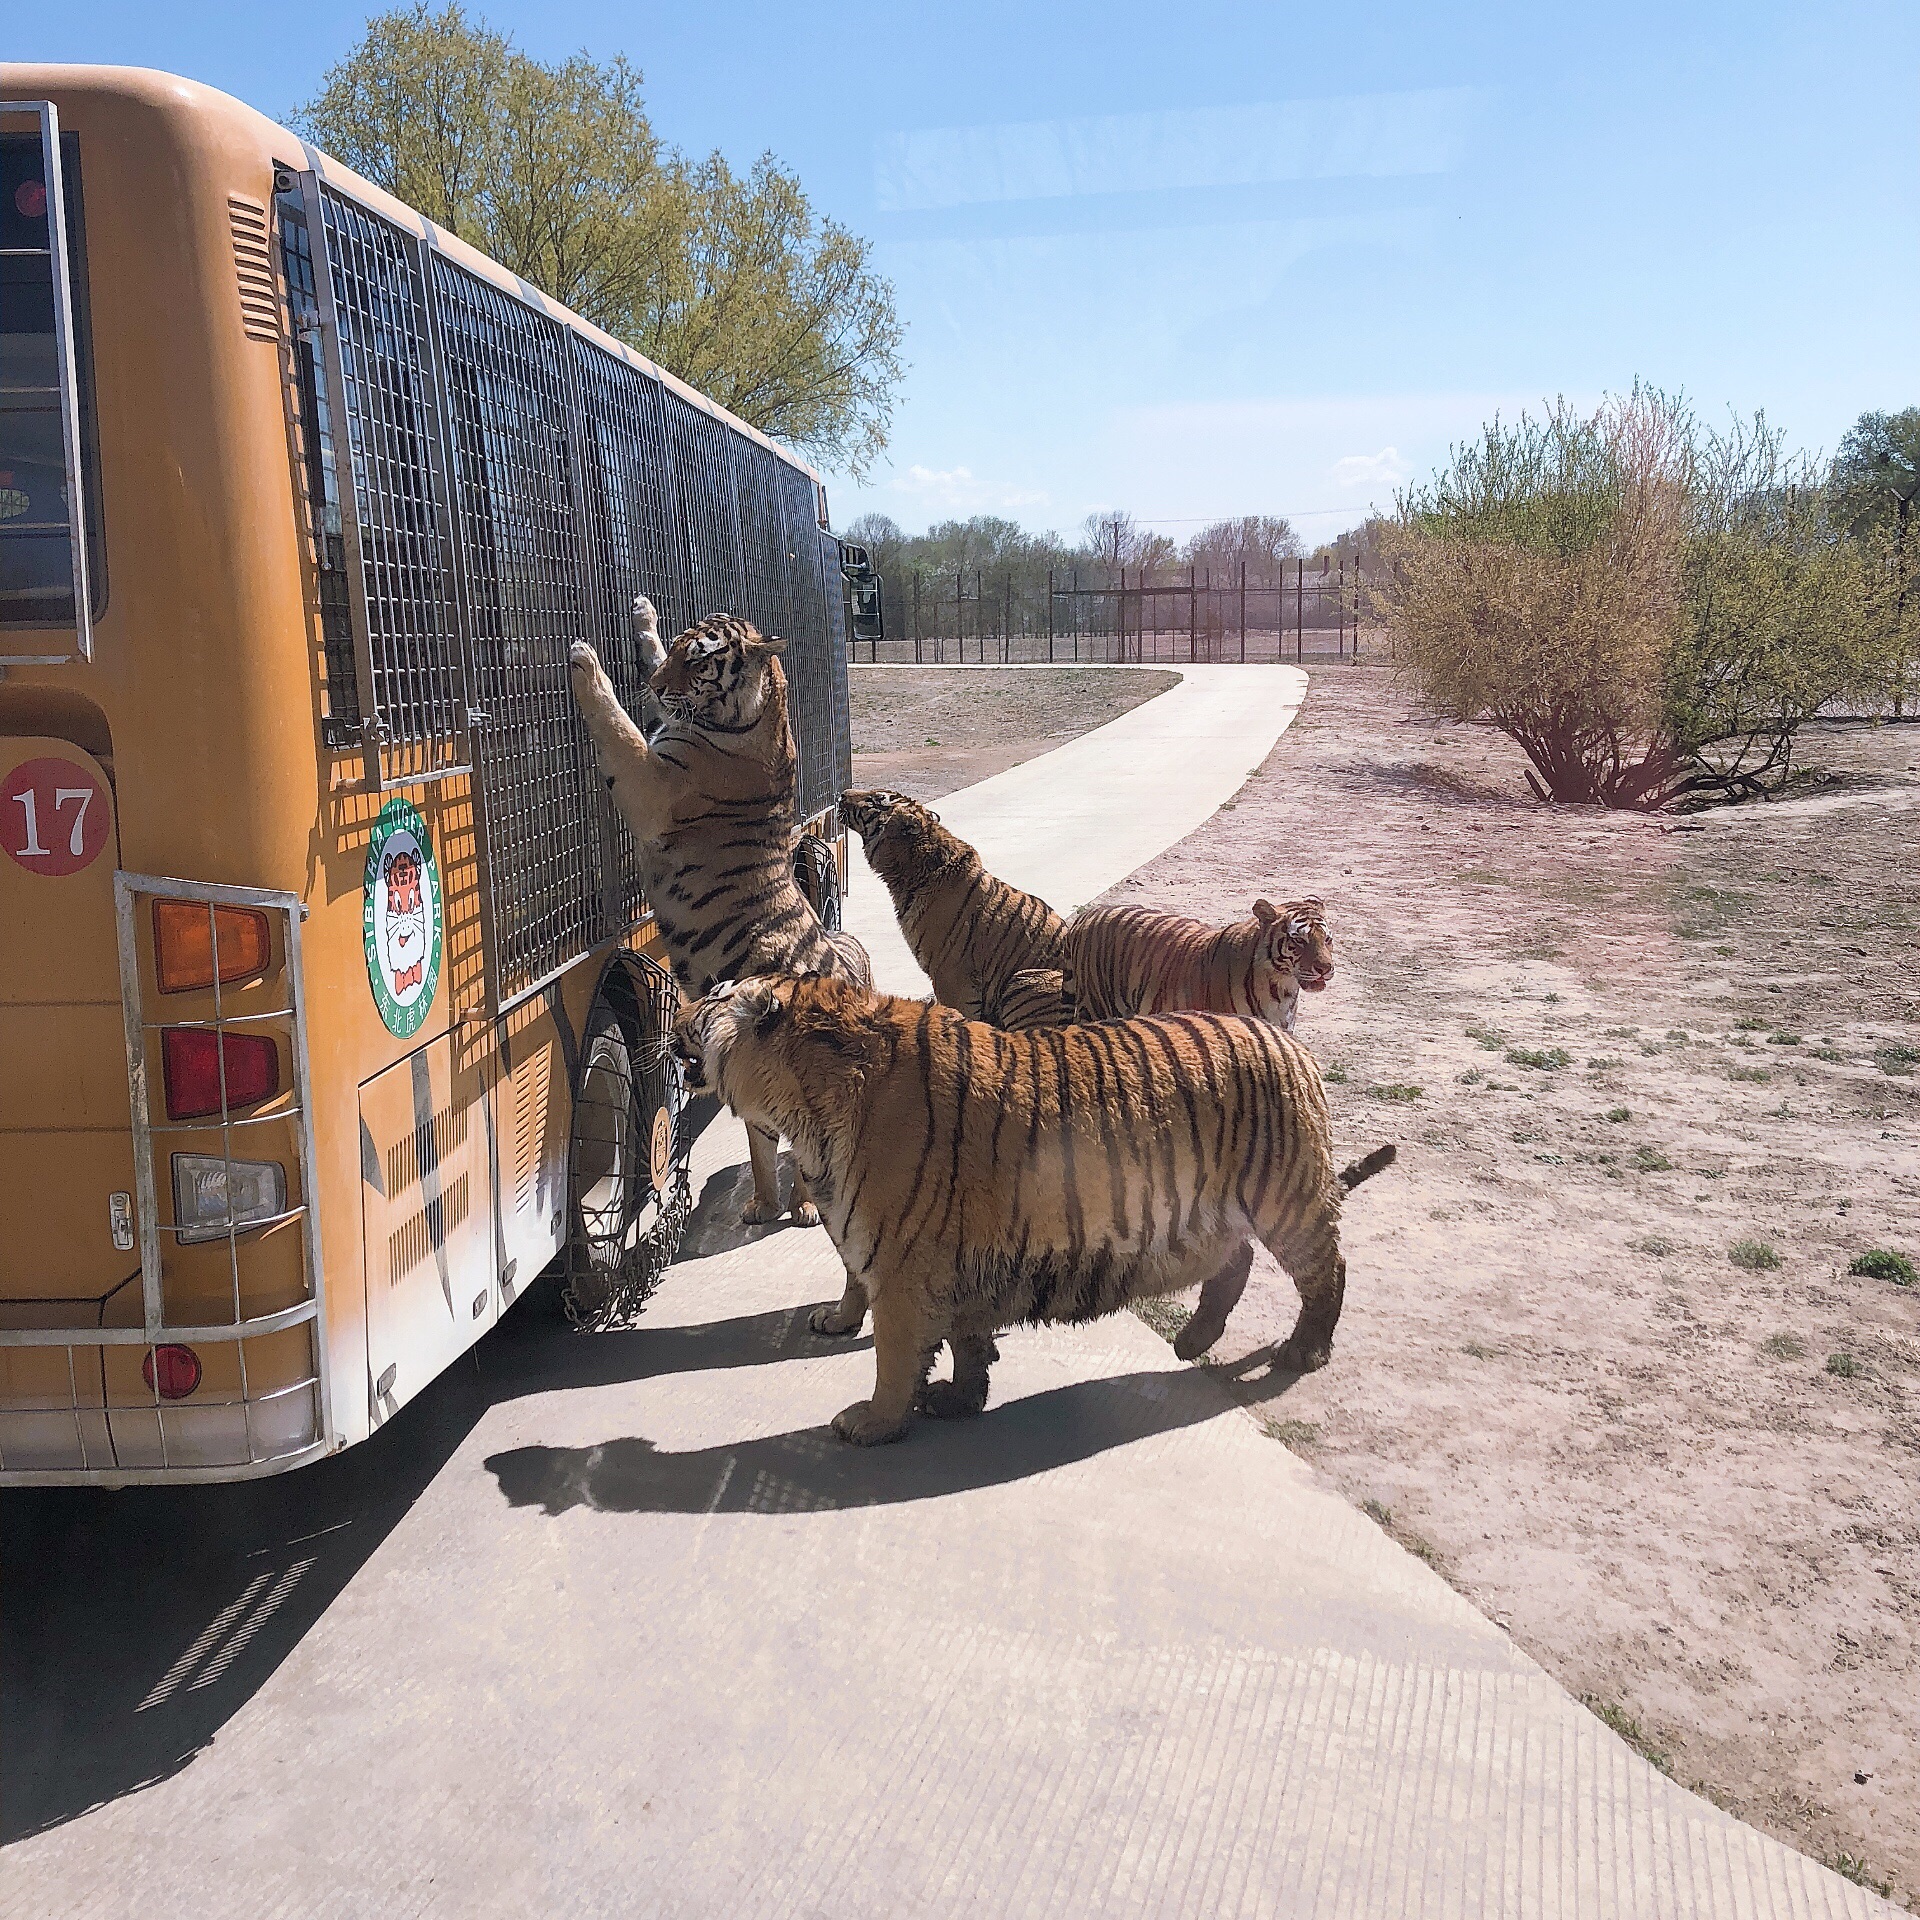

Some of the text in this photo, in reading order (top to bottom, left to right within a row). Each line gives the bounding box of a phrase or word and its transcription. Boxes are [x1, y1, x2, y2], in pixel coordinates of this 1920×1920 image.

[12, 788, 93, 856] 17
[388, 803, 425, 846] TIGER
[427, 854, 442, 943] PARK
[379, 965, 439, 1034] 东北虎林园
